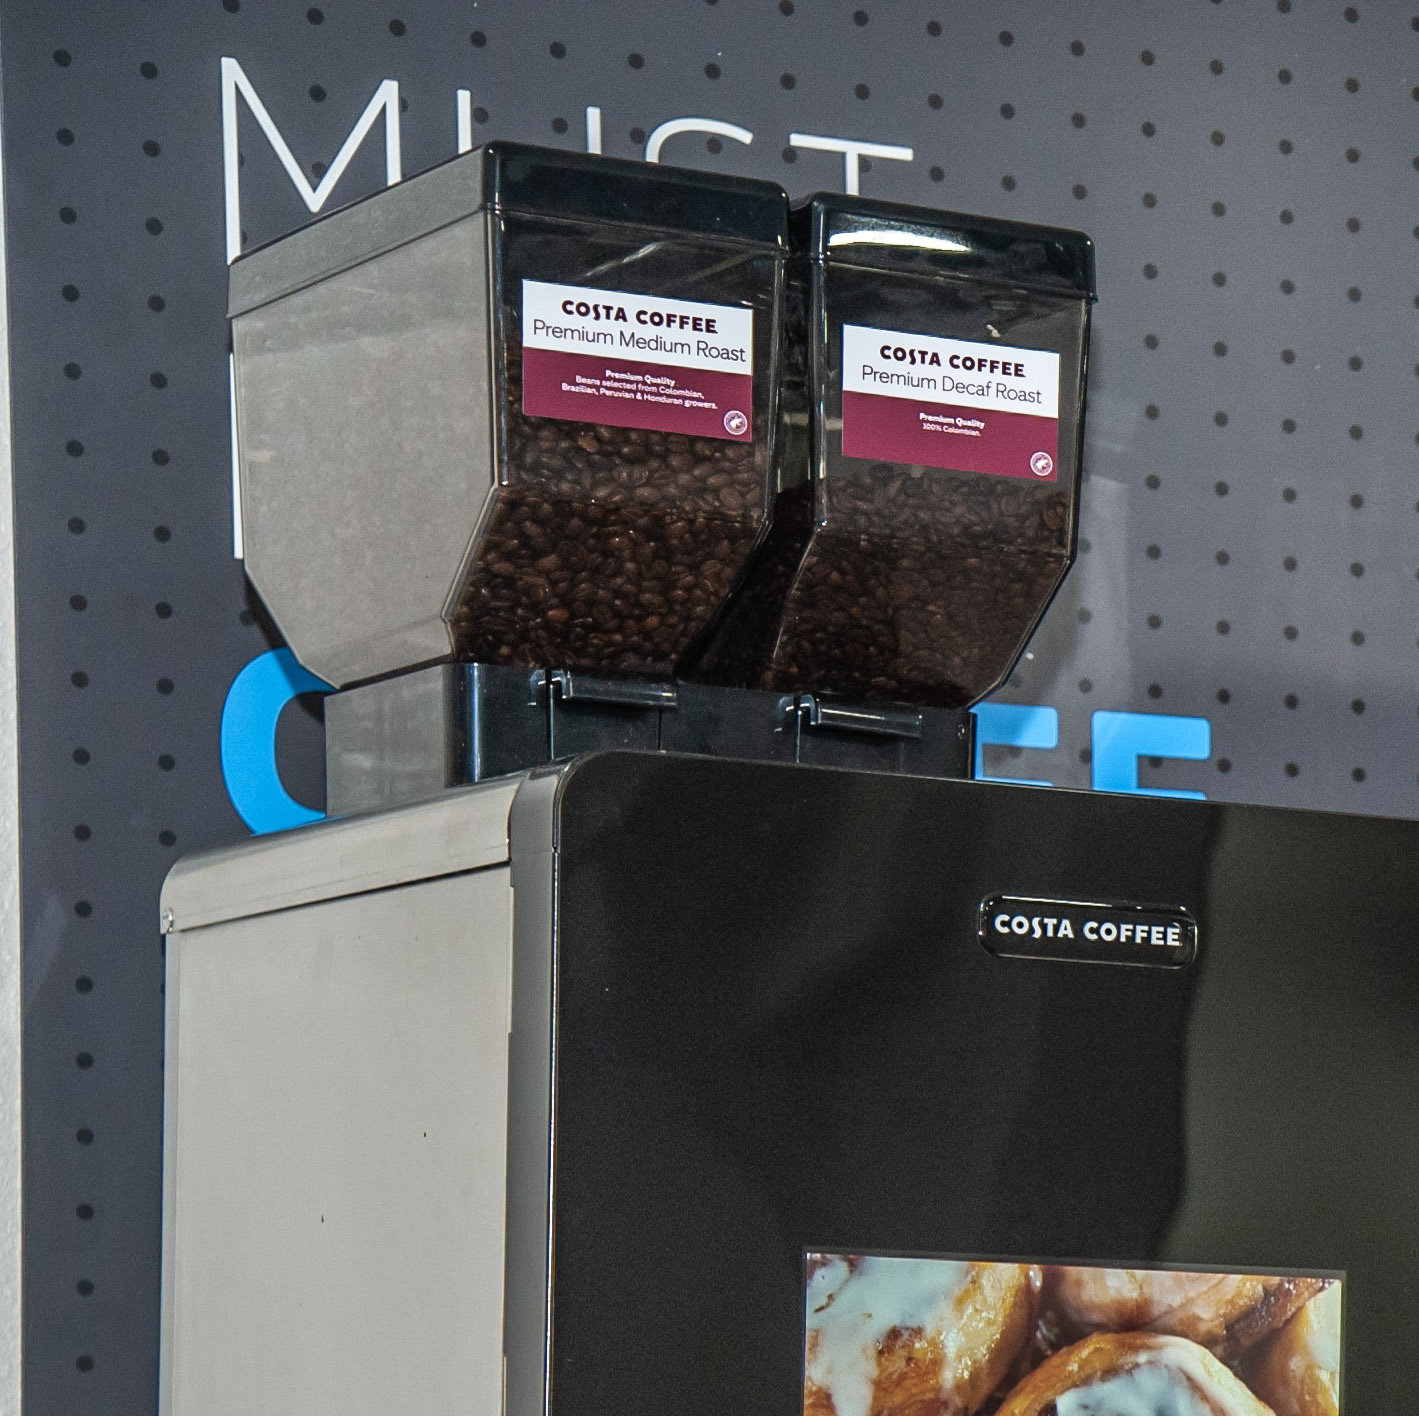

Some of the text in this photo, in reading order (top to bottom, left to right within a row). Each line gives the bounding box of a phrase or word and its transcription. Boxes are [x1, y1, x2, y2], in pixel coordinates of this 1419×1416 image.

[561, 300, 718, 334] COSTA COFFEE
[533, 319, 746, 363] Premium Medium Roast
[605, 369, 675, 387] Premium Quality
[879, 345, 1027, 378] COSTA COFFEE
[576, 375, 600, 386] Beans
[602, 379, 636, 391] selected
[638, 383, 657, 393] from
[862, 365, 1042, 404] Premium Decaf Roast
[994, 914, 1182, 946] COSTA COFFEE
